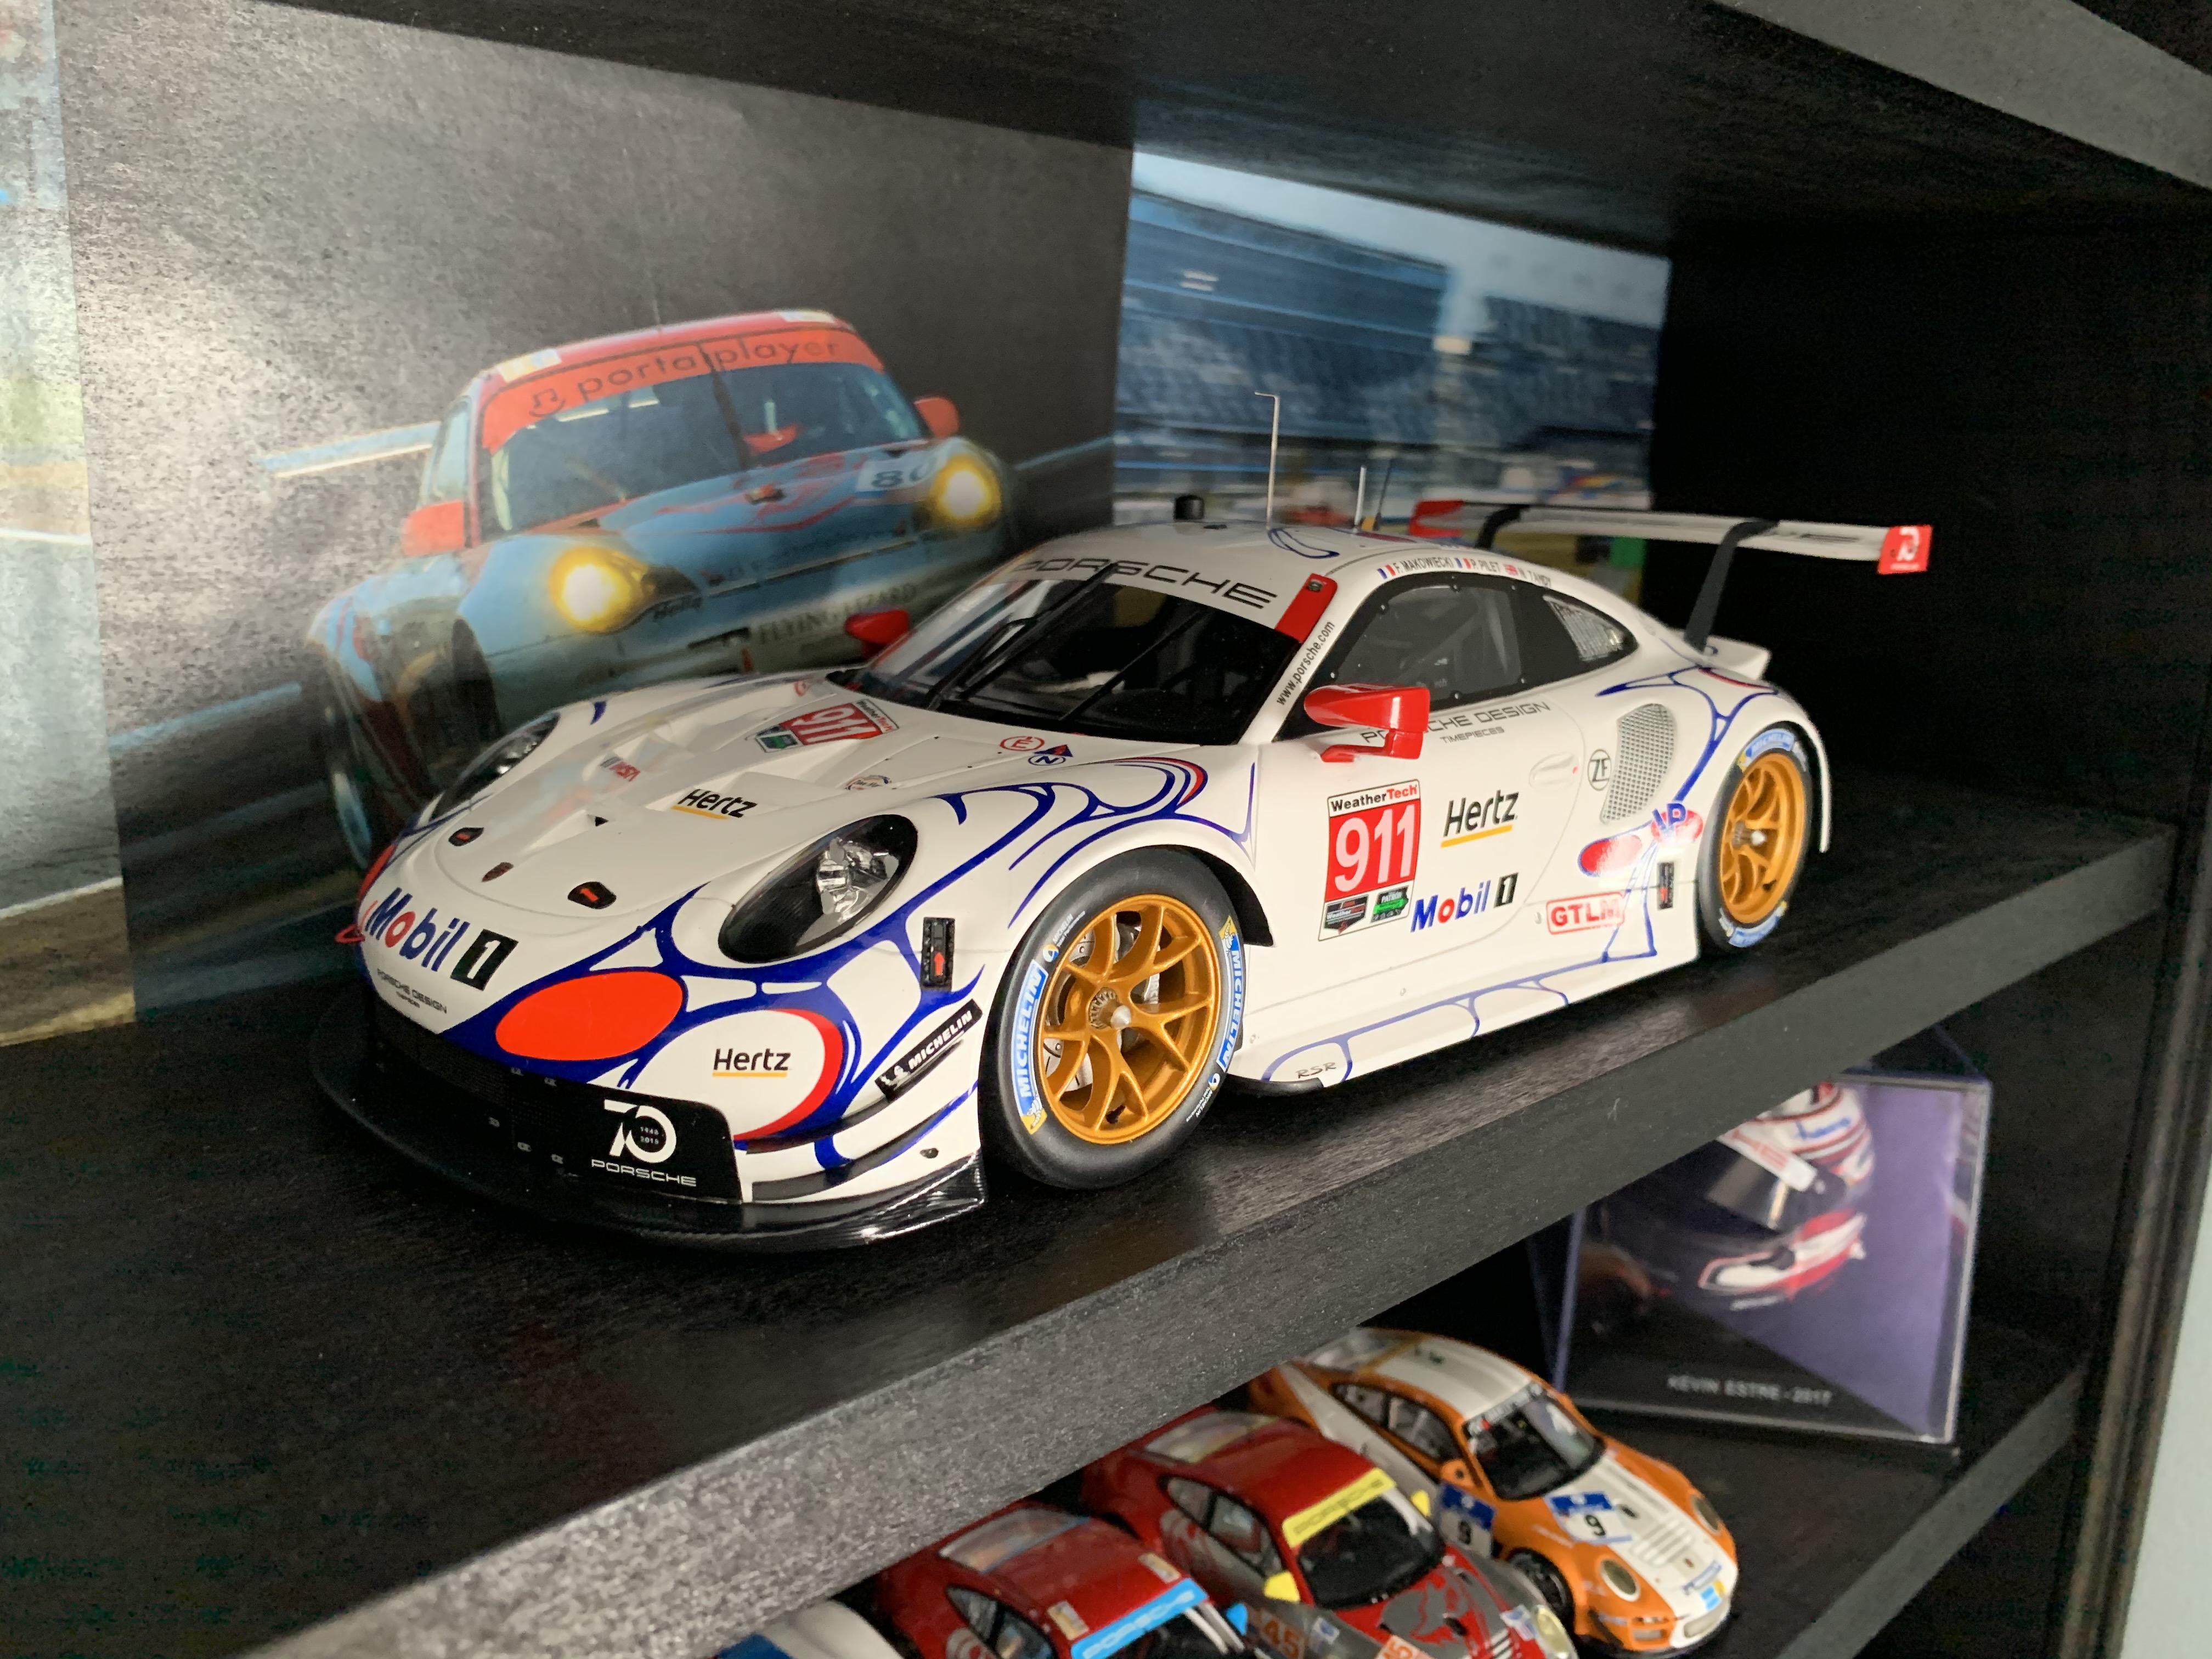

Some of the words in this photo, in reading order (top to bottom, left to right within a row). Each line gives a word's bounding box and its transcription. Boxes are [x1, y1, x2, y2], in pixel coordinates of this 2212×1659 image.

[1012, 557, 1278, 610] PORSCHE
[1277, 621, 1335, 706] www.porsche.com
[1474, 701, 1551, 723] DESIGN
[1440, 726, 1505, 744] TIMEPIECES
[1589, 758, 1611, 782] ZF
[678, 788, 758, 818] Hertz
[1331, 785, 1417, 812] WeatherTech
[1443, 789, 1519, 838] Hertz
[1334, 804, 1415, 893] 911
[1410, 880, 1491, 933] Mobil
[1551, 898, 1621, 927] GTLM
[365, 887, 471, 972] Mobil
[411, 989, 447, 1014] DESIGN
[1222, 949, 1243, 1068] MICHELIN
[908, 1010, 973, 1070] MICHELIN
[1016, 969, 1042, 1098] MICHELIN
[713, 1048, 792, 1071] Hertz
[1295, 1062, 1337, 1079] RSR
[604, 1098, 677, 1164] 70
[591, 1159, 697, 1187] PORSCHE
[1584, 1514, 1606, 1537] 9
